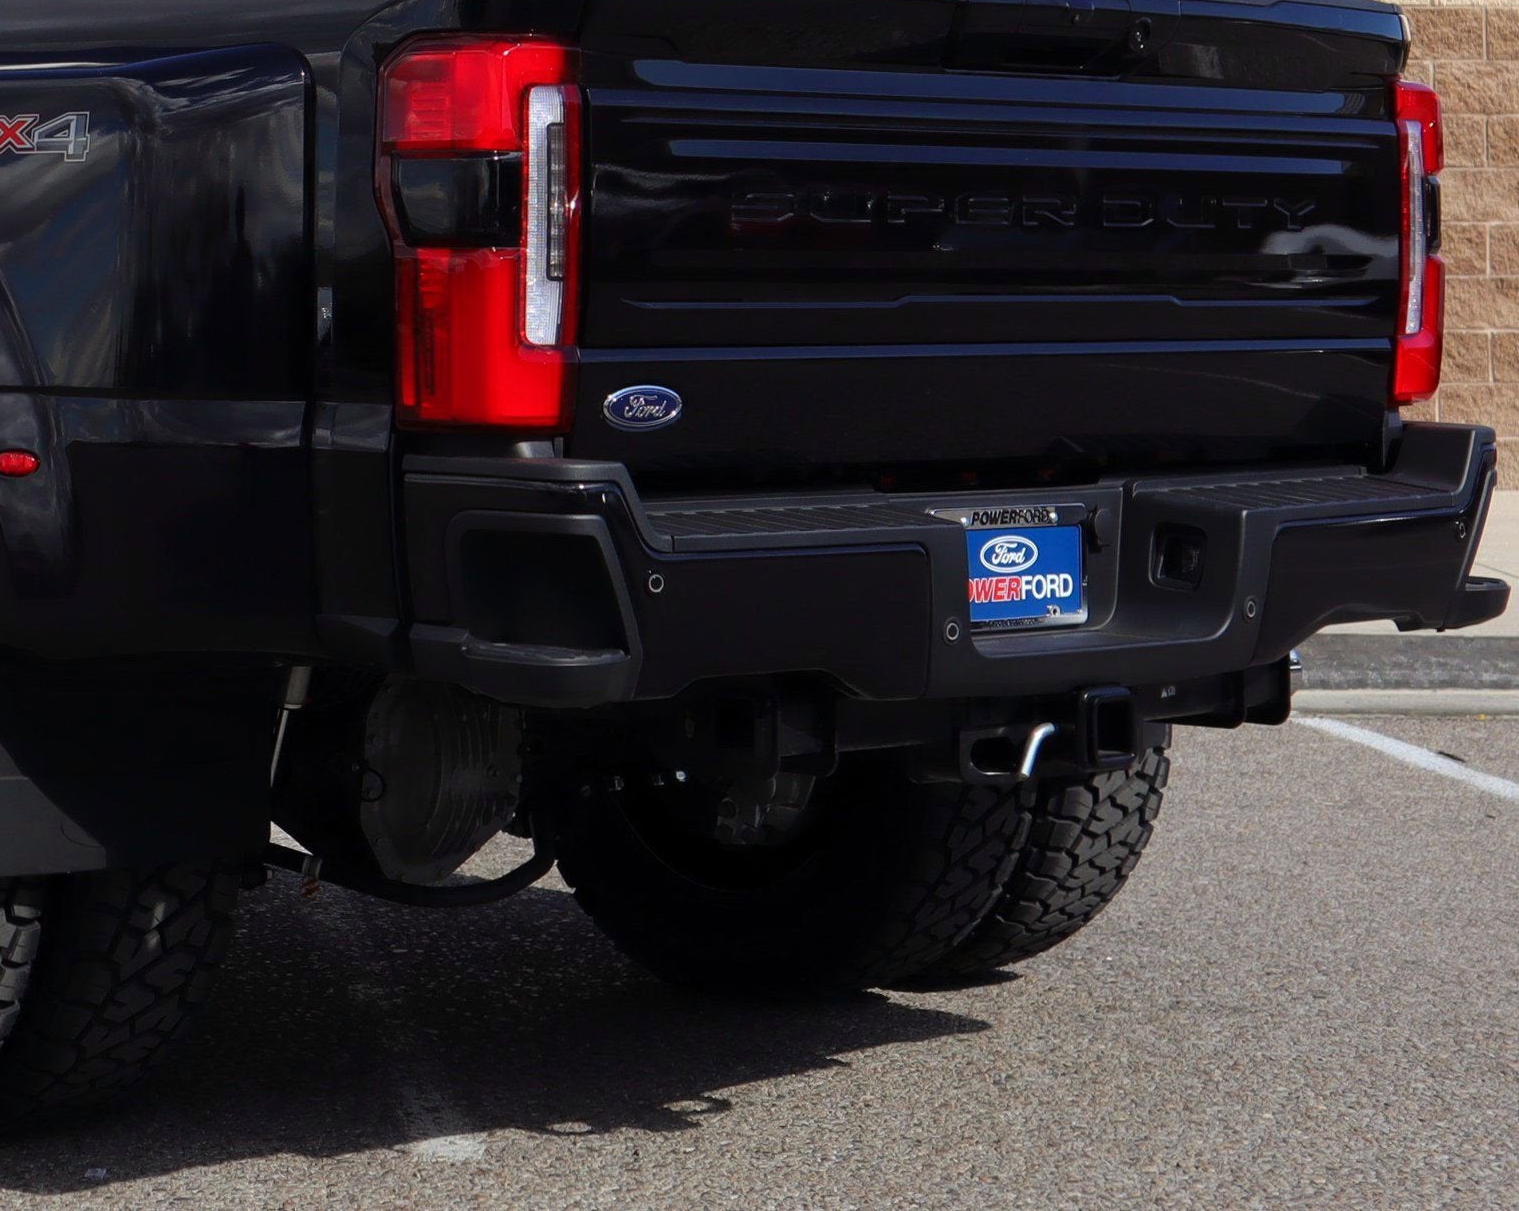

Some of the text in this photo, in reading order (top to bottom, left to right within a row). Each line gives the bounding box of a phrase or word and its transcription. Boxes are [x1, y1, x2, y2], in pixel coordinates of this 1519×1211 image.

[729, 191, 1318, 233] SUPER DUTY
[624, 394, 667, 418] Ford
[992, 542, 1026, 565] Ford
